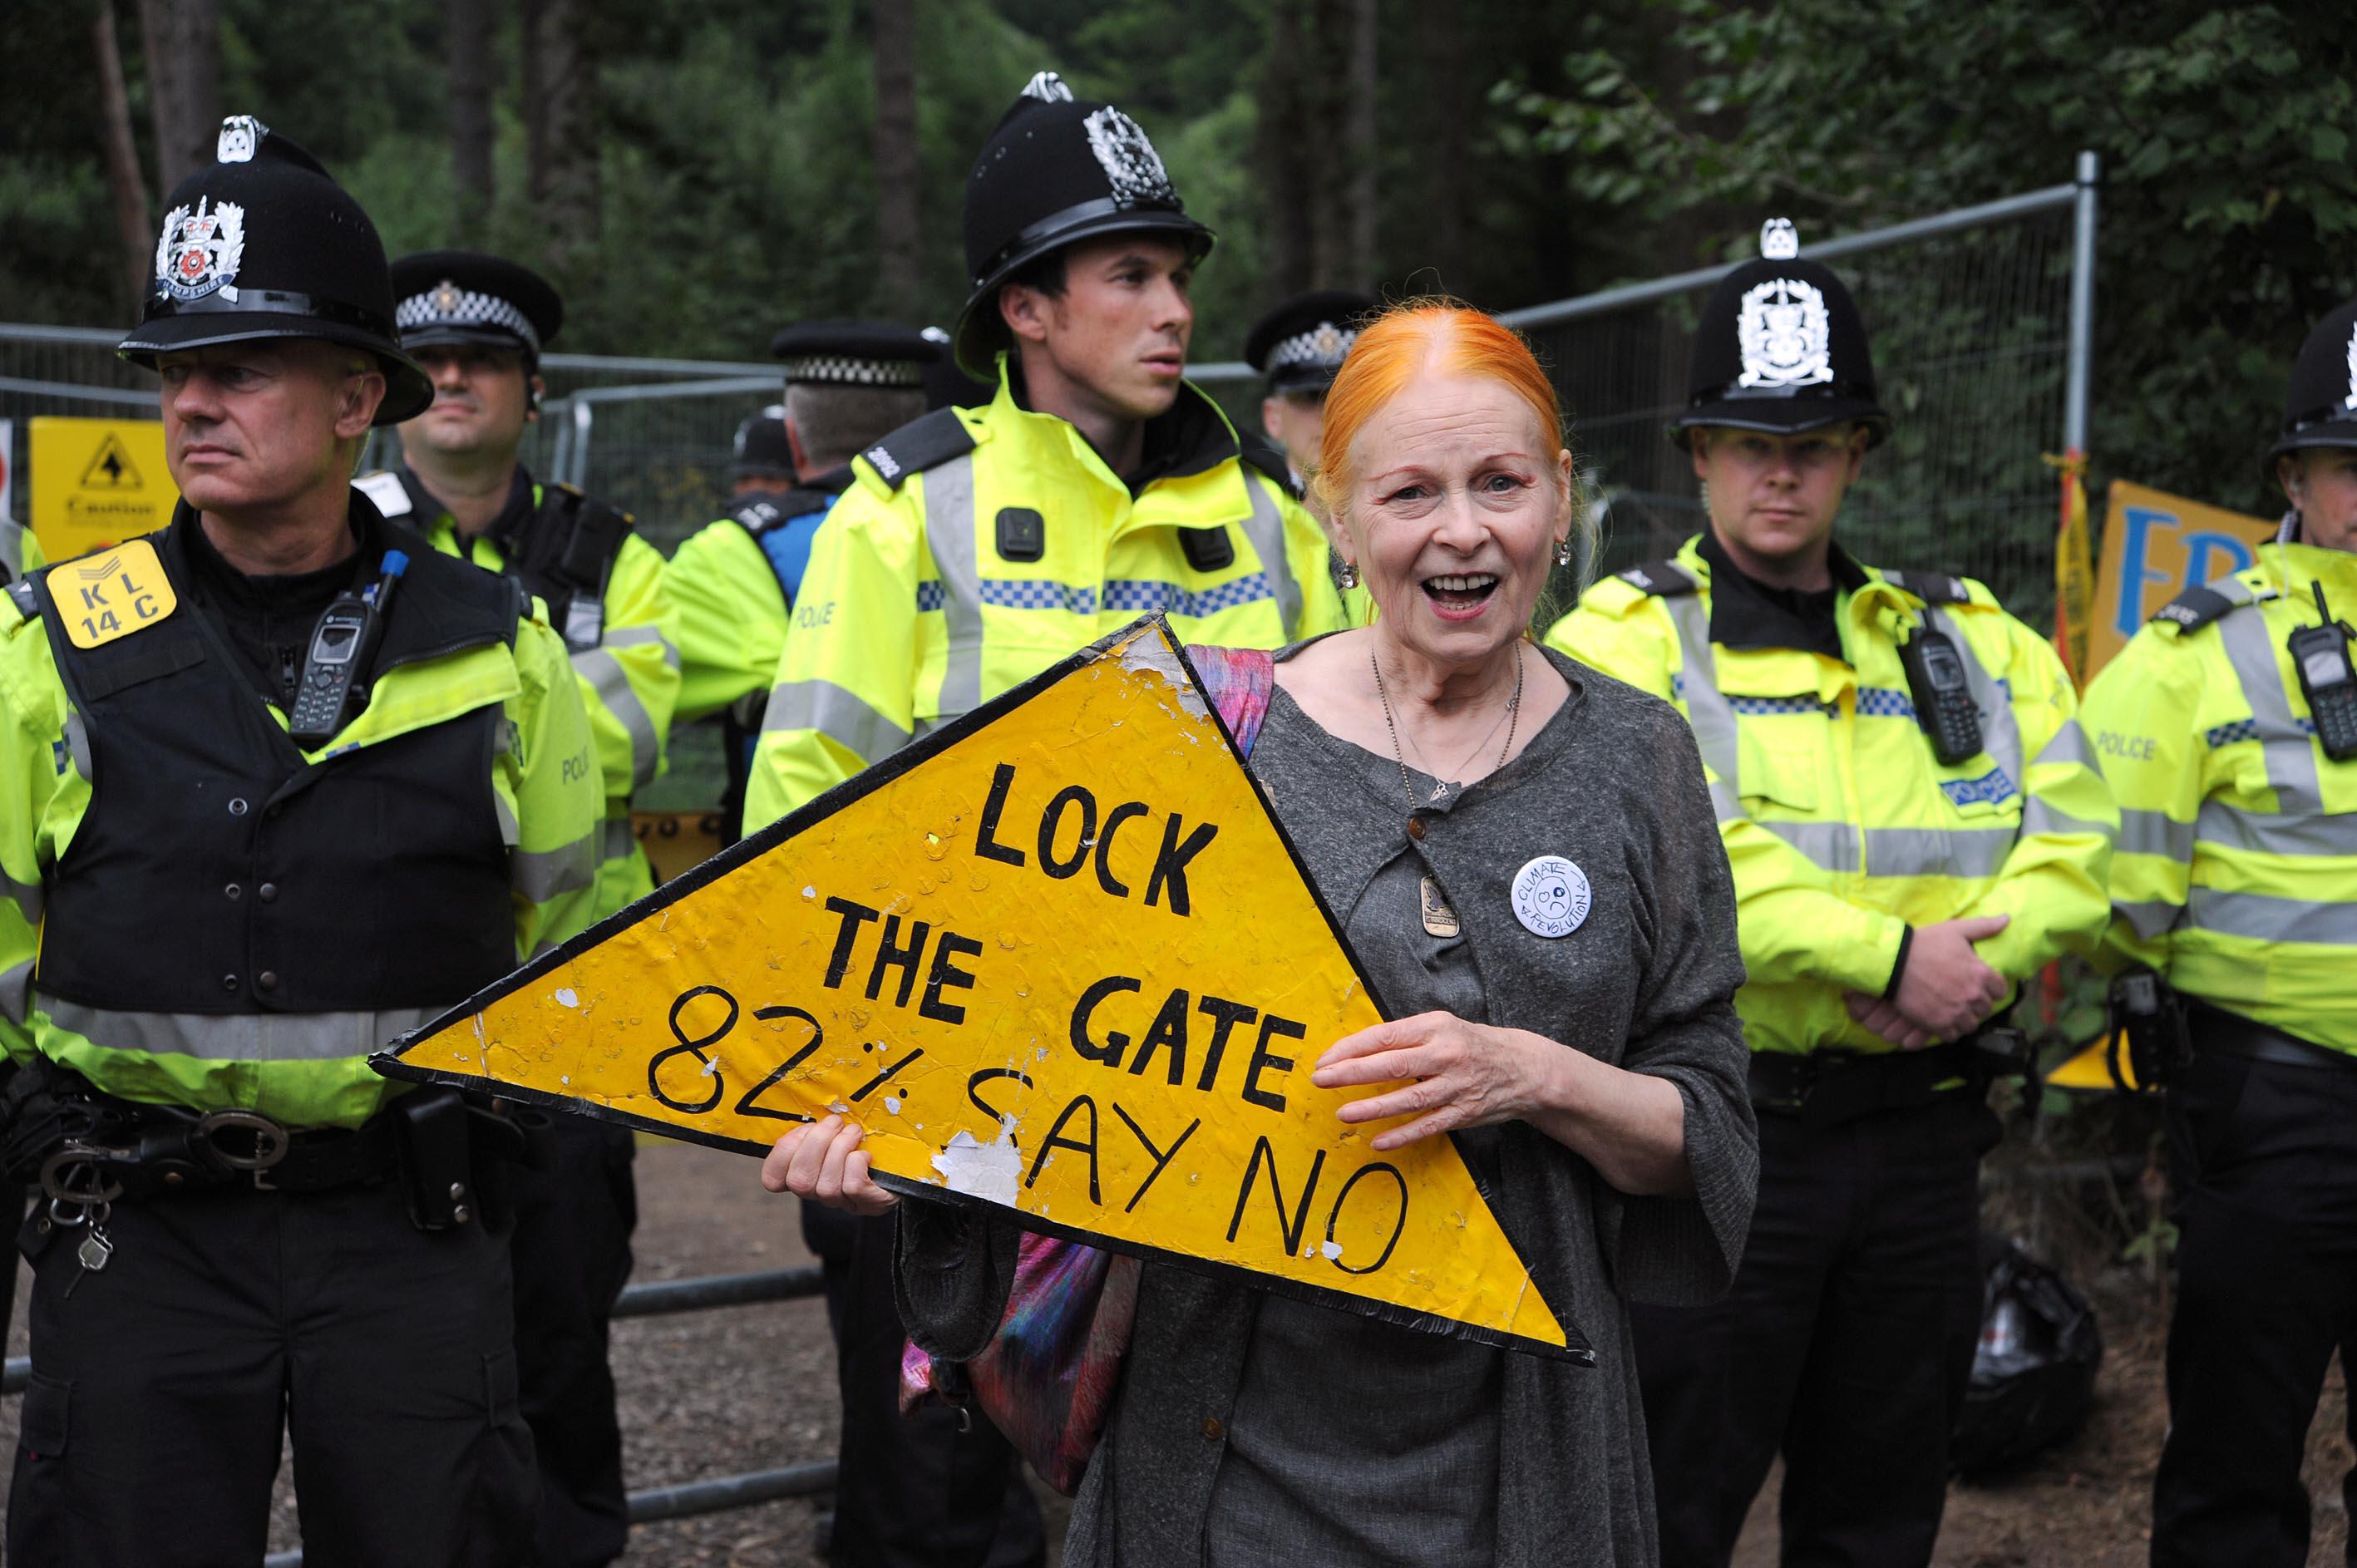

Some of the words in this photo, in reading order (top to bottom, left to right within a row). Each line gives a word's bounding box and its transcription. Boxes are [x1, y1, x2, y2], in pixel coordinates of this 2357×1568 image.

[81, 584, 110, 610] K
[121, 573, 143, 594] L
[81, 610, 121, 639] 14
[135, 594, 159, 619] C
[974, 762, 1219, 917] LOCK
[1518, 861, 1568, 901] CLIMATE
[1531, 895, 1587, 934] REVOLUTION
[823, 895, 983, 1025] THE
[1069, 975, 1307, 1113] GATE
[648, 985, 925, 1124] 82%
[954, 1068, 1201, 1214] SAY
[1225, 1136, 1409, 1275] NO
